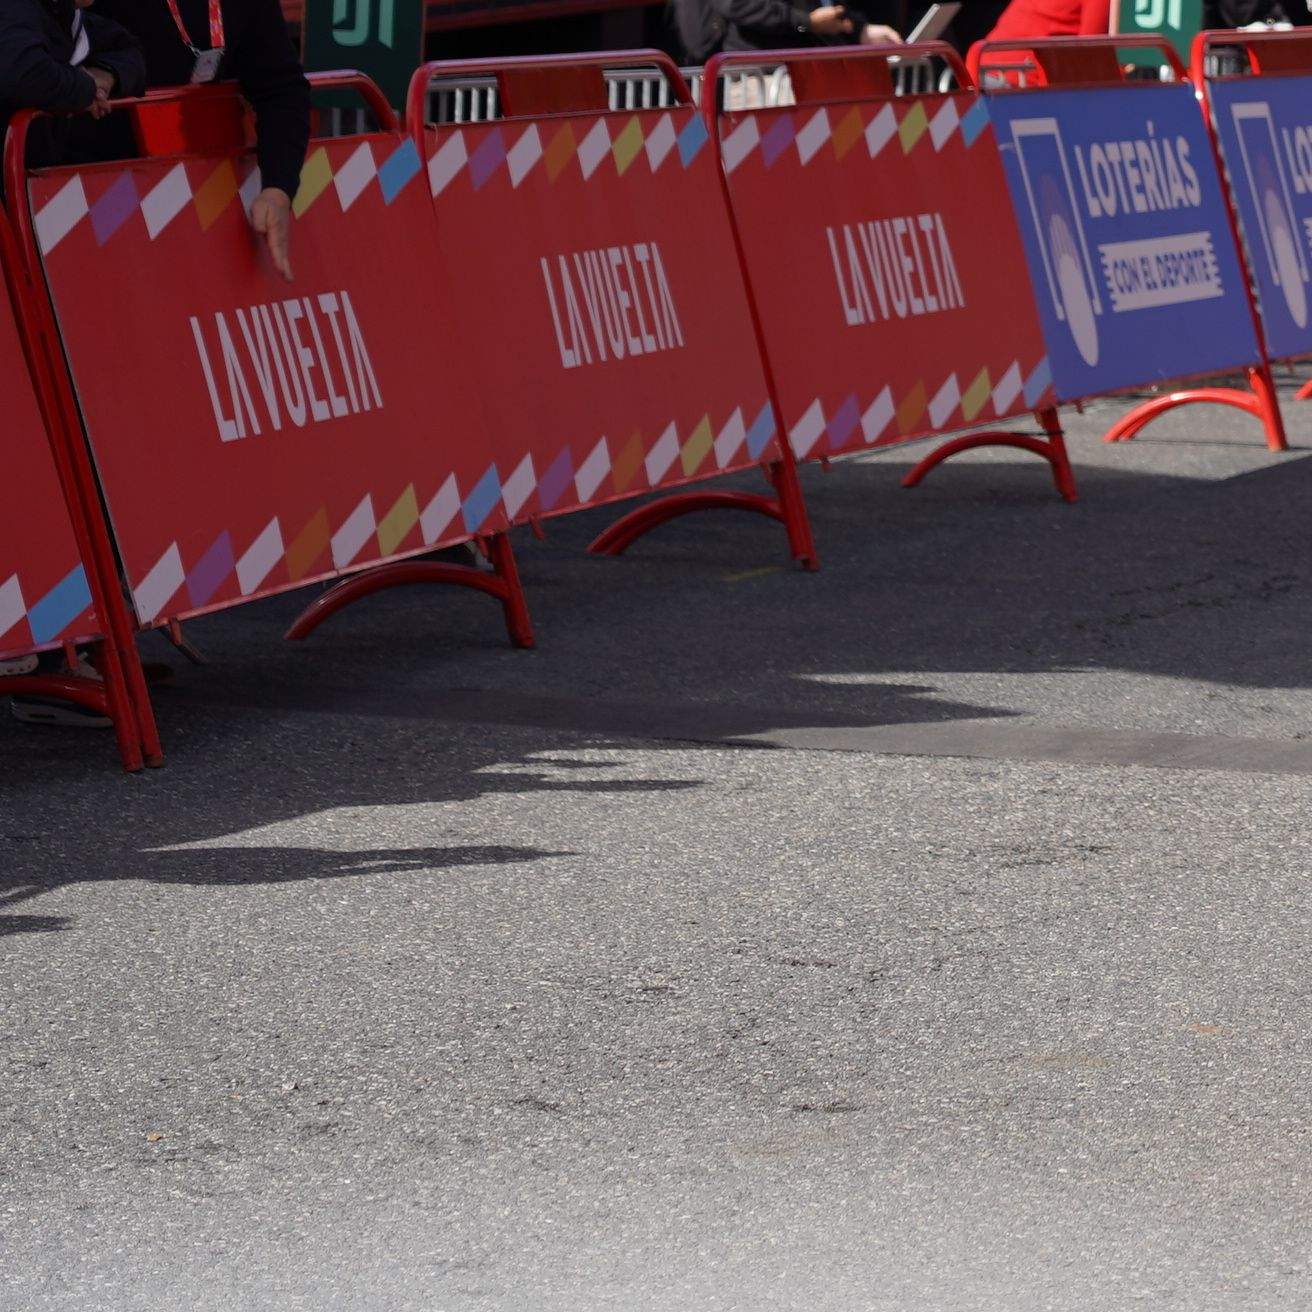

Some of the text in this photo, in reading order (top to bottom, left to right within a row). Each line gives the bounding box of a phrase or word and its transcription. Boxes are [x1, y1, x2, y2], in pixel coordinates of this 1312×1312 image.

[1074, 120, 1201, 218] LOTERÍAS
[541, 242, 685, 368] LA VUELTA
[826, 213, 965, 326] LA VUELTA
[1155, 249, 1211, 288] DEPORTE
[190, 290, 383, 442] LA VUELTA
